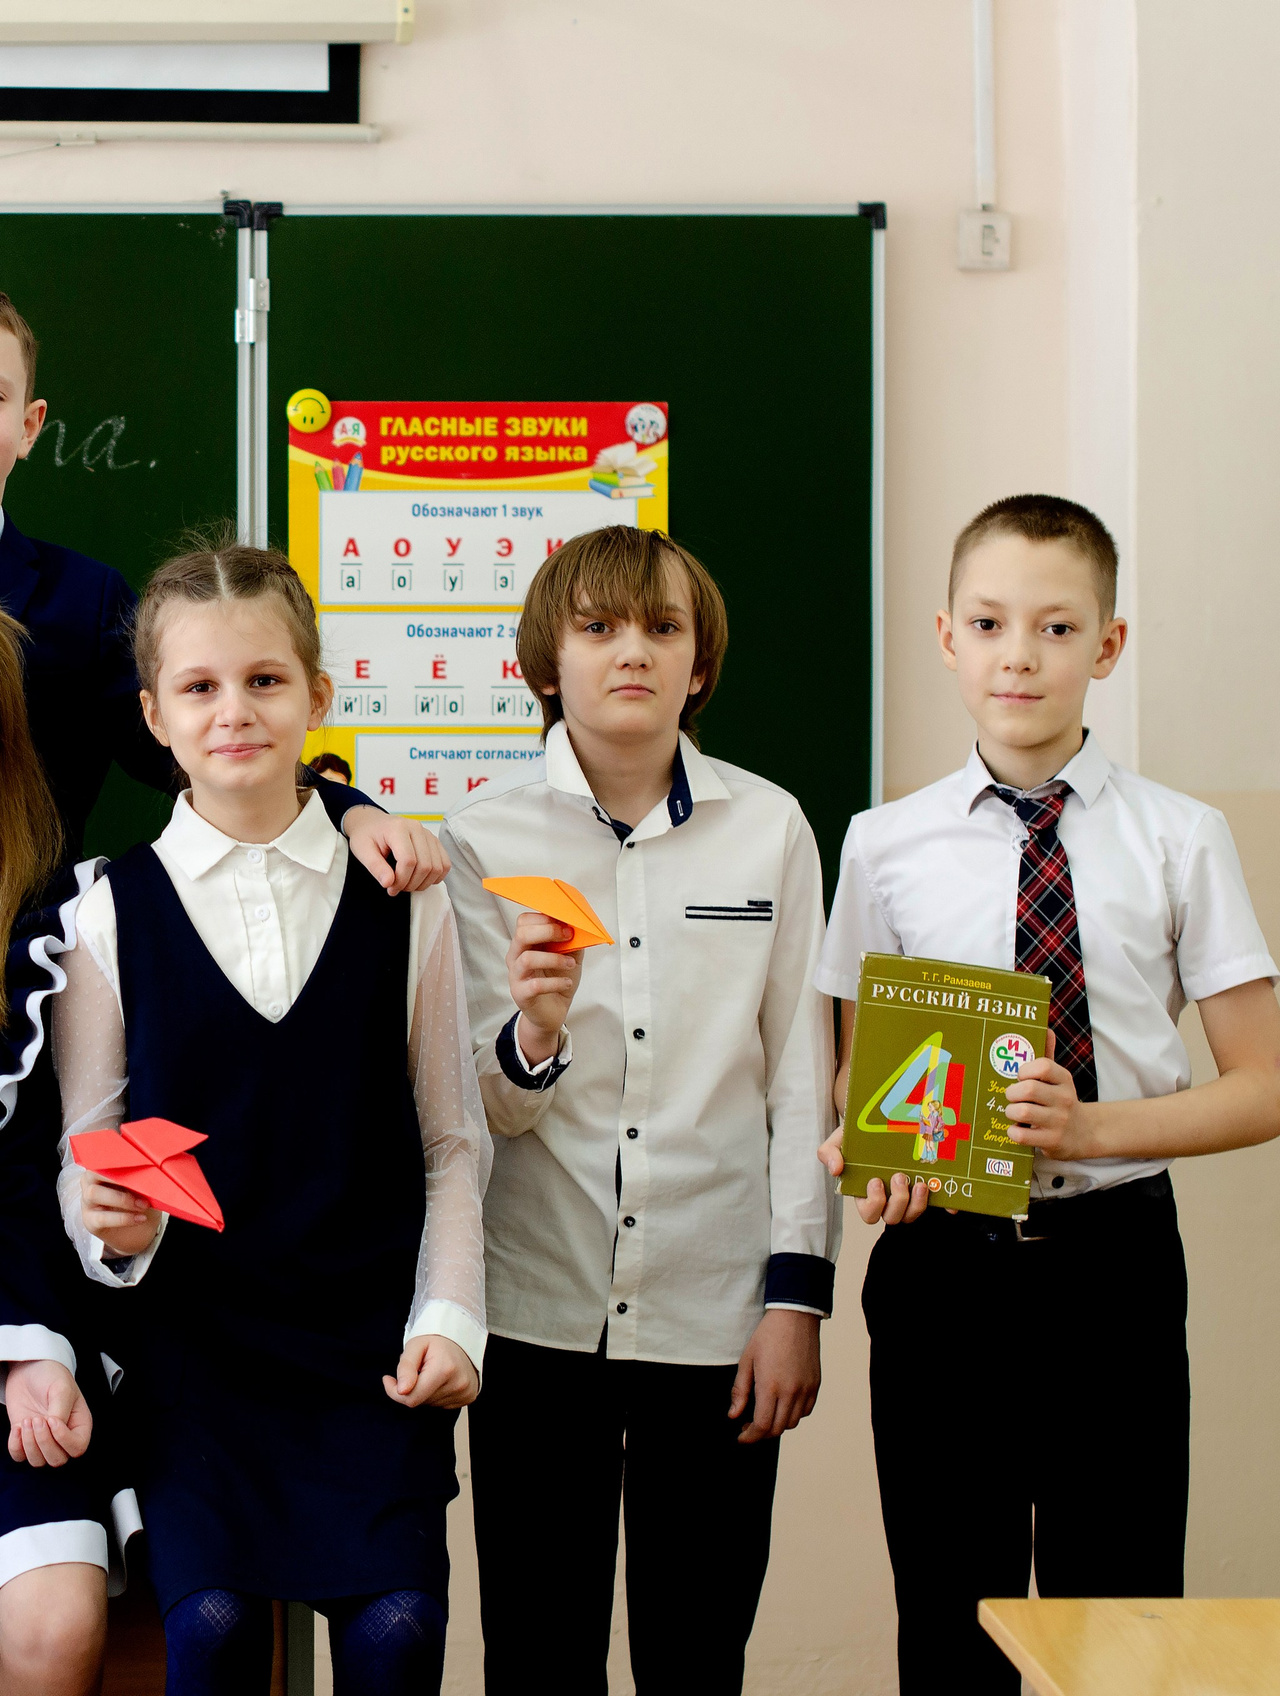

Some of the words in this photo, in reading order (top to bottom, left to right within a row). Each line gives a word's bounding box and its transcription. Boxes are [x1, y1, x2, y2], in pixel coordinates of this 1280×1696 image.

[380, 416, 499, 437] ГЛАСНЫЕ
[504, 416, 588, 437] ЗВУКИ
[380, 445, 498, 466] русского
[504, 445, 588, 462] языка
[411, 503, 498, 517] Обозначают
[502, 503, 508, 517] 1
[511, 505, 543, 520] звук
[343, 537, 361, 557] А
[393, 537, 412, 558] О
[445, 537, 462, 557] У
[496, 537, 513, 557] Э
[406, 624, 493, 638] Обозначают
[497, 624, 505, 638] 2
[355, 659, 370, 679] Е
[432, 654, 447, 679] Ё
[409, 746, 471, 760] Смягчают
[379, 777, 395, 796] Я
[425, 772, 438, 796] Ё
[922, 971, 931, 981] Т.
[932, 973, 940, 983] Г.
[943, 974, 992, 990] Рамзаева
[871, 983, 971, 1010] РУССКИЙ
[976, 997, 1038, 1021] ЯЗЫК
[986, 1096, 996, 1111] 4
[990, 1116, 1010, 1131] Час
